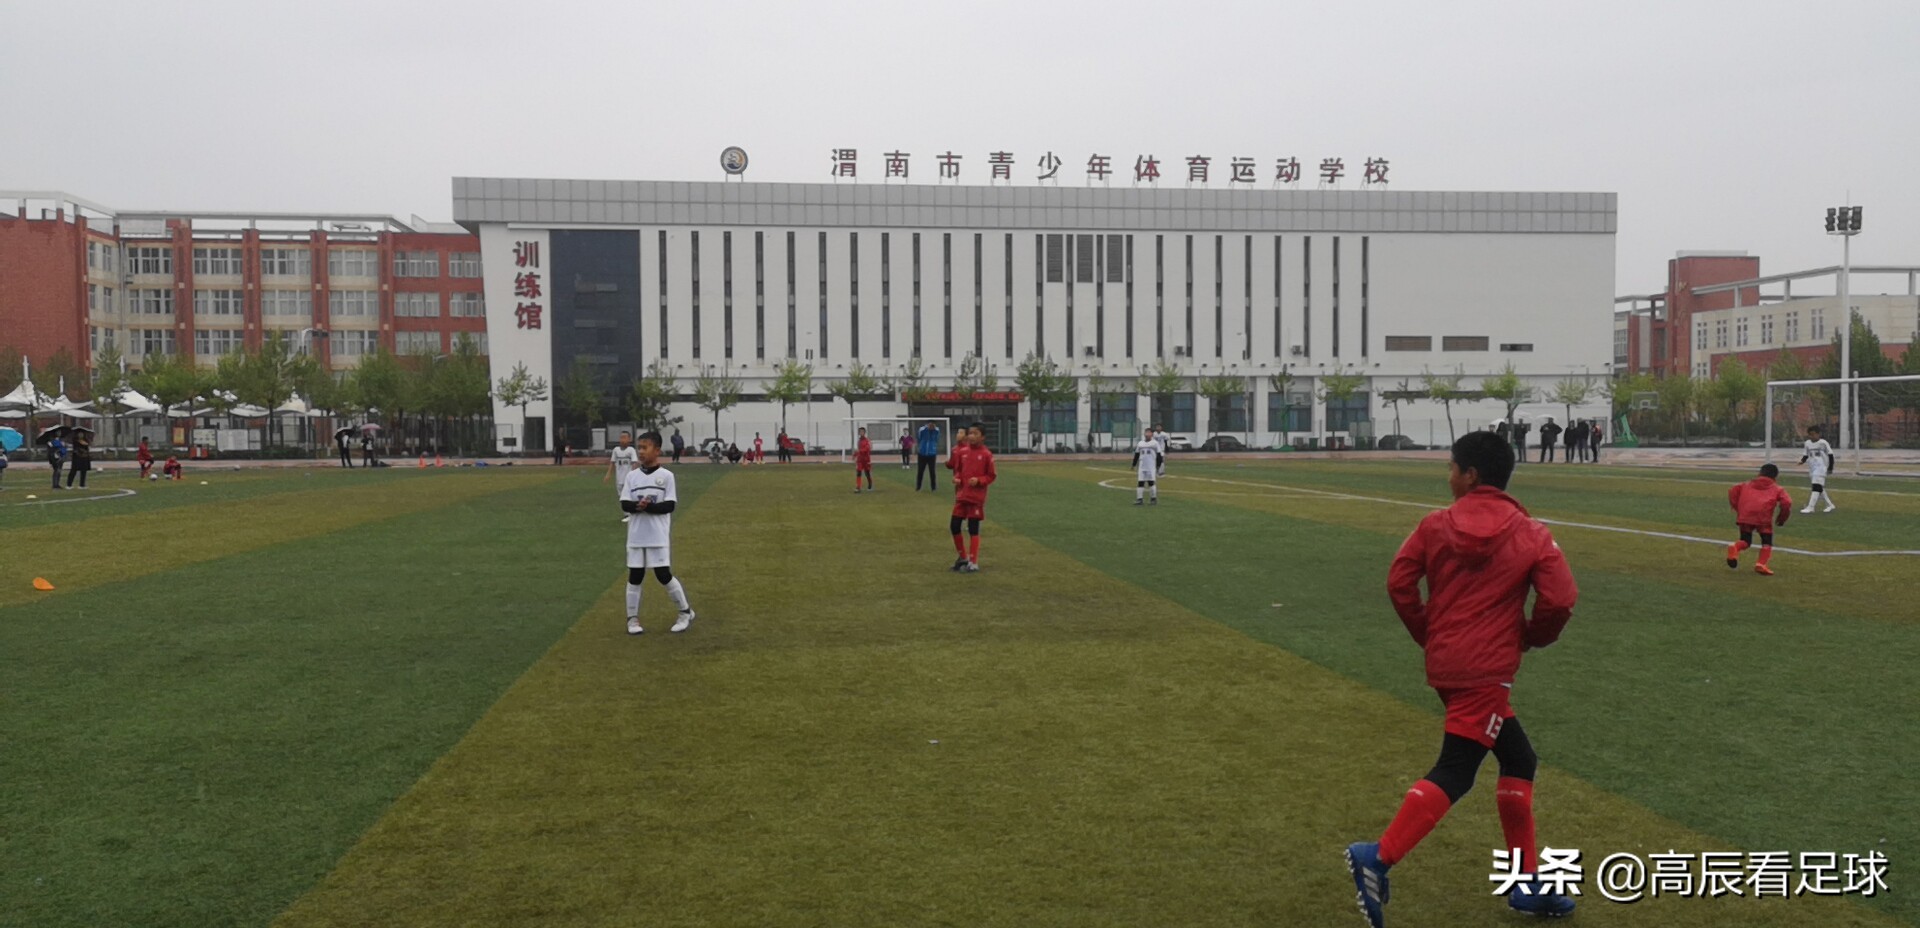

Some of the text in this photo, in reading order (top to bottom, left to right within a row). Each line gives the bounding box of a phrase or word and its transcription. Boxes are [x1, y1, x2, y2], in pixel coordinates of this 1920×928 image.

[831, 148, 1390, 184] 渭南市青少年体育运动学校
[512, 240, 542, 330] 训练馆
[1485, 712, 1504, 740] 13
